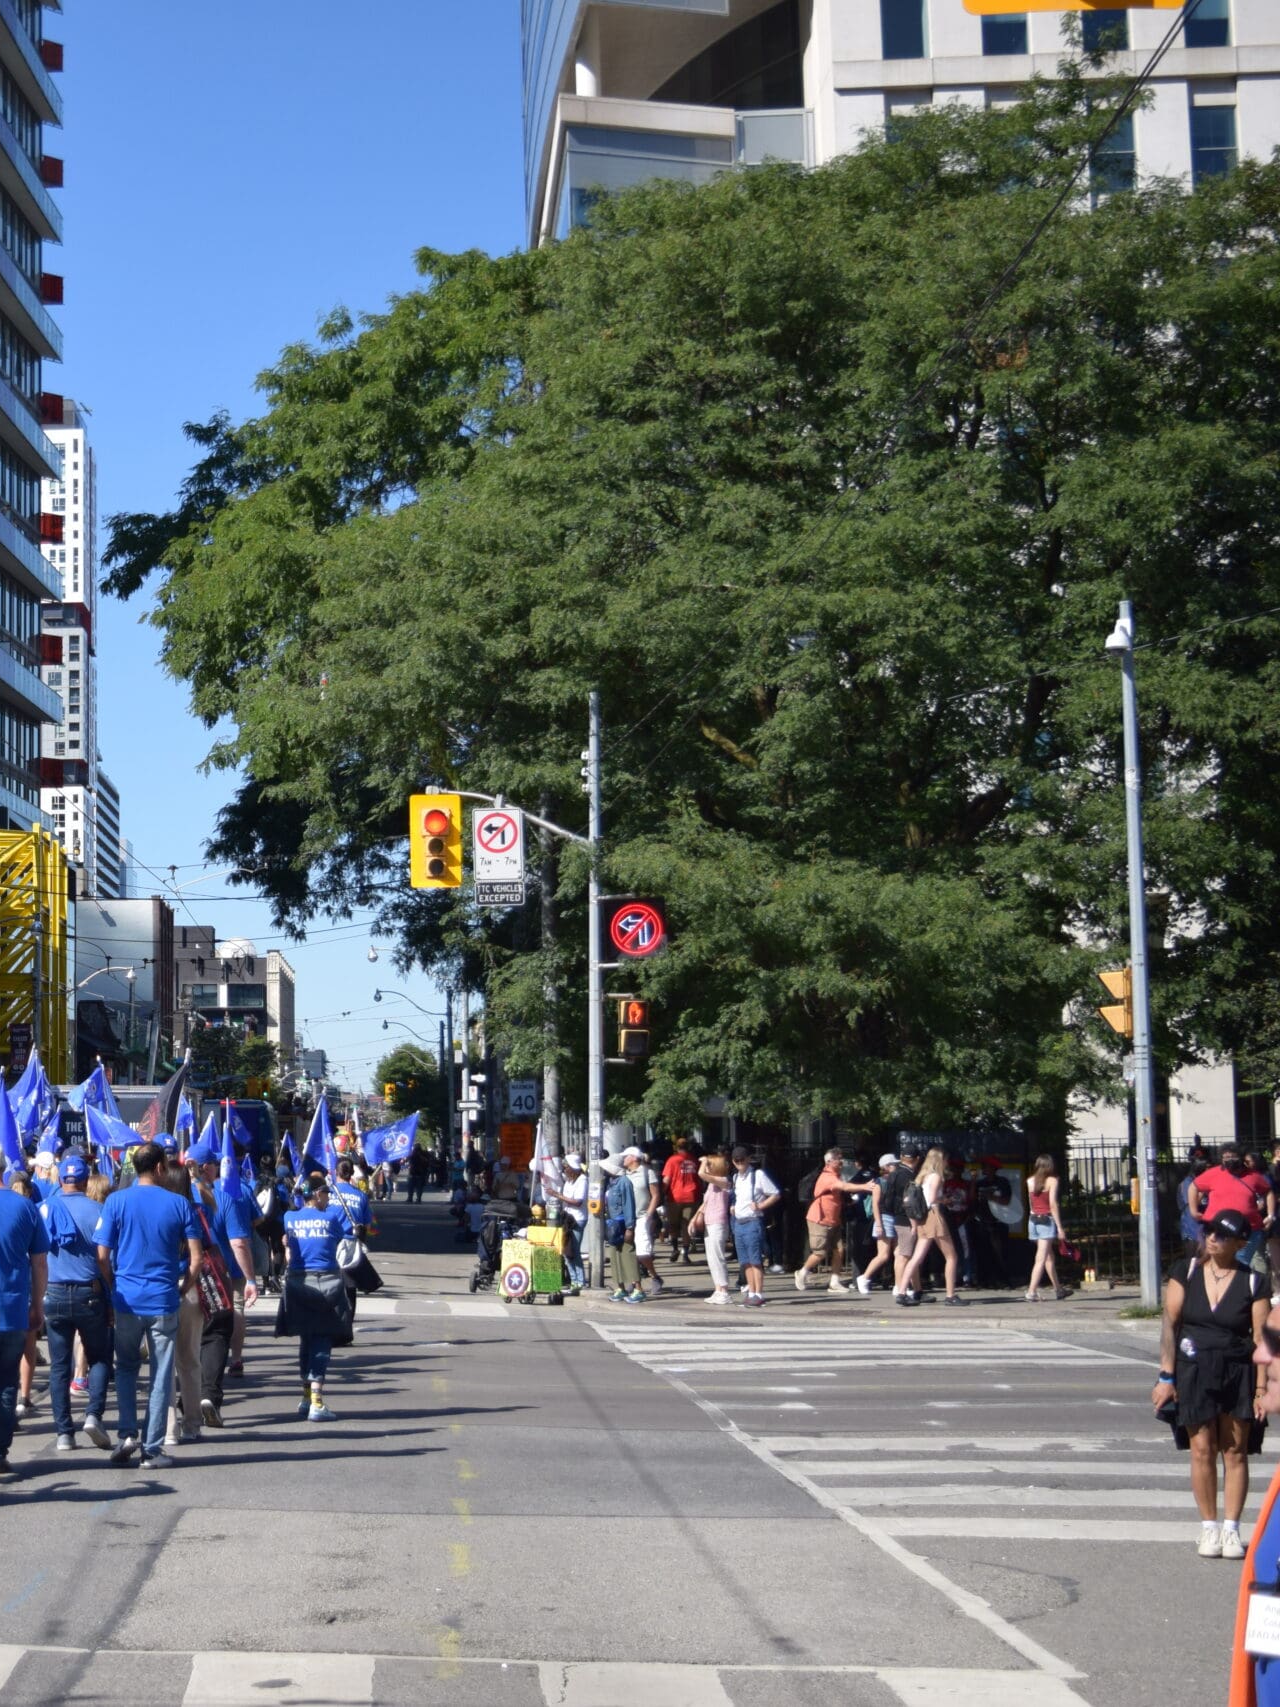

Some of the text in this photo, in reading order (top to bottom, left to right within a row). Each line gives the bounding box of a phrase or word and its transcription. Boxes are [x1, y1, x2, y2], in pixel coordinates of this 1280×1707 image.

[477, 885, 522, 893] TTC VEHICLES
[479, 894, 521, 902] EXCEPTED
[512, 1095, 535, 1111] 40
[65, 1121, 83, 1133] THE
[294, 1219, 330, 1229] UNION
[308, 1229, 329, 1238] ALL
